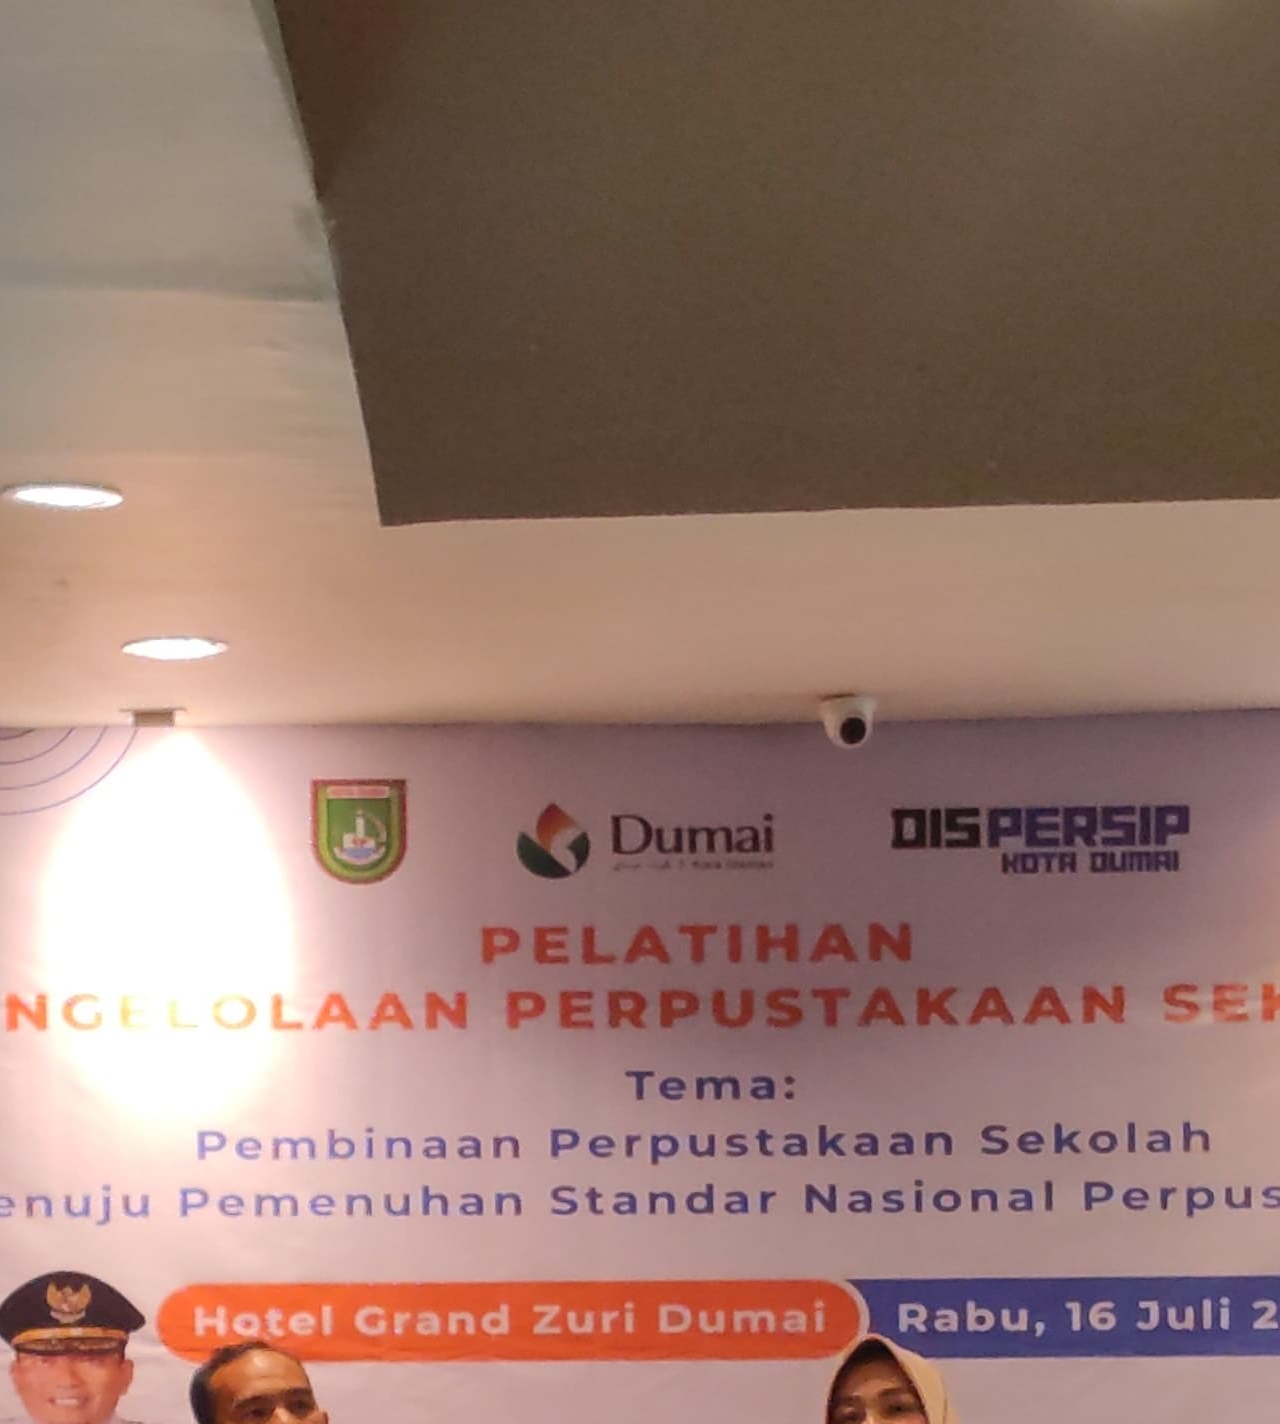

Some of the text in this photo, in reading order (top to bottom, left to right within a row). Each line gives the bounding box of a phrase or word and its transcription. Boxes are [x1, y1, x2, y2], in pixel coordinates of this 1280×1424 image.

[610, 813, 774, 855] Dumai
[890, 804, 1190, 850] DISPERSIP
[1001, 849, 1180, 875] KOTA DUMAI
[480, 921, 912, 966] PELATIHAN
[505, 984, 1126, 1030] PERPUSTAKAAN
[624, 1070, 796, 1101] Tema:
[197, 1121, 1211, 1166] Pembinaan Perpustakaan Sekolah
[179, 1184, 523, 1218] Pemenuhan
[550, 1183, 777, 1216] Standar
[804, 1179, 1054, 1214] Nasional
[194, 1300, 825, 1338] Hotel Grand Zuri Dumai
[898, 1300, 1046, 1337] Rabu,
[1065, 1301, 1117, 1332] 16
[1136, 1296, 1230, 1331] Juli
